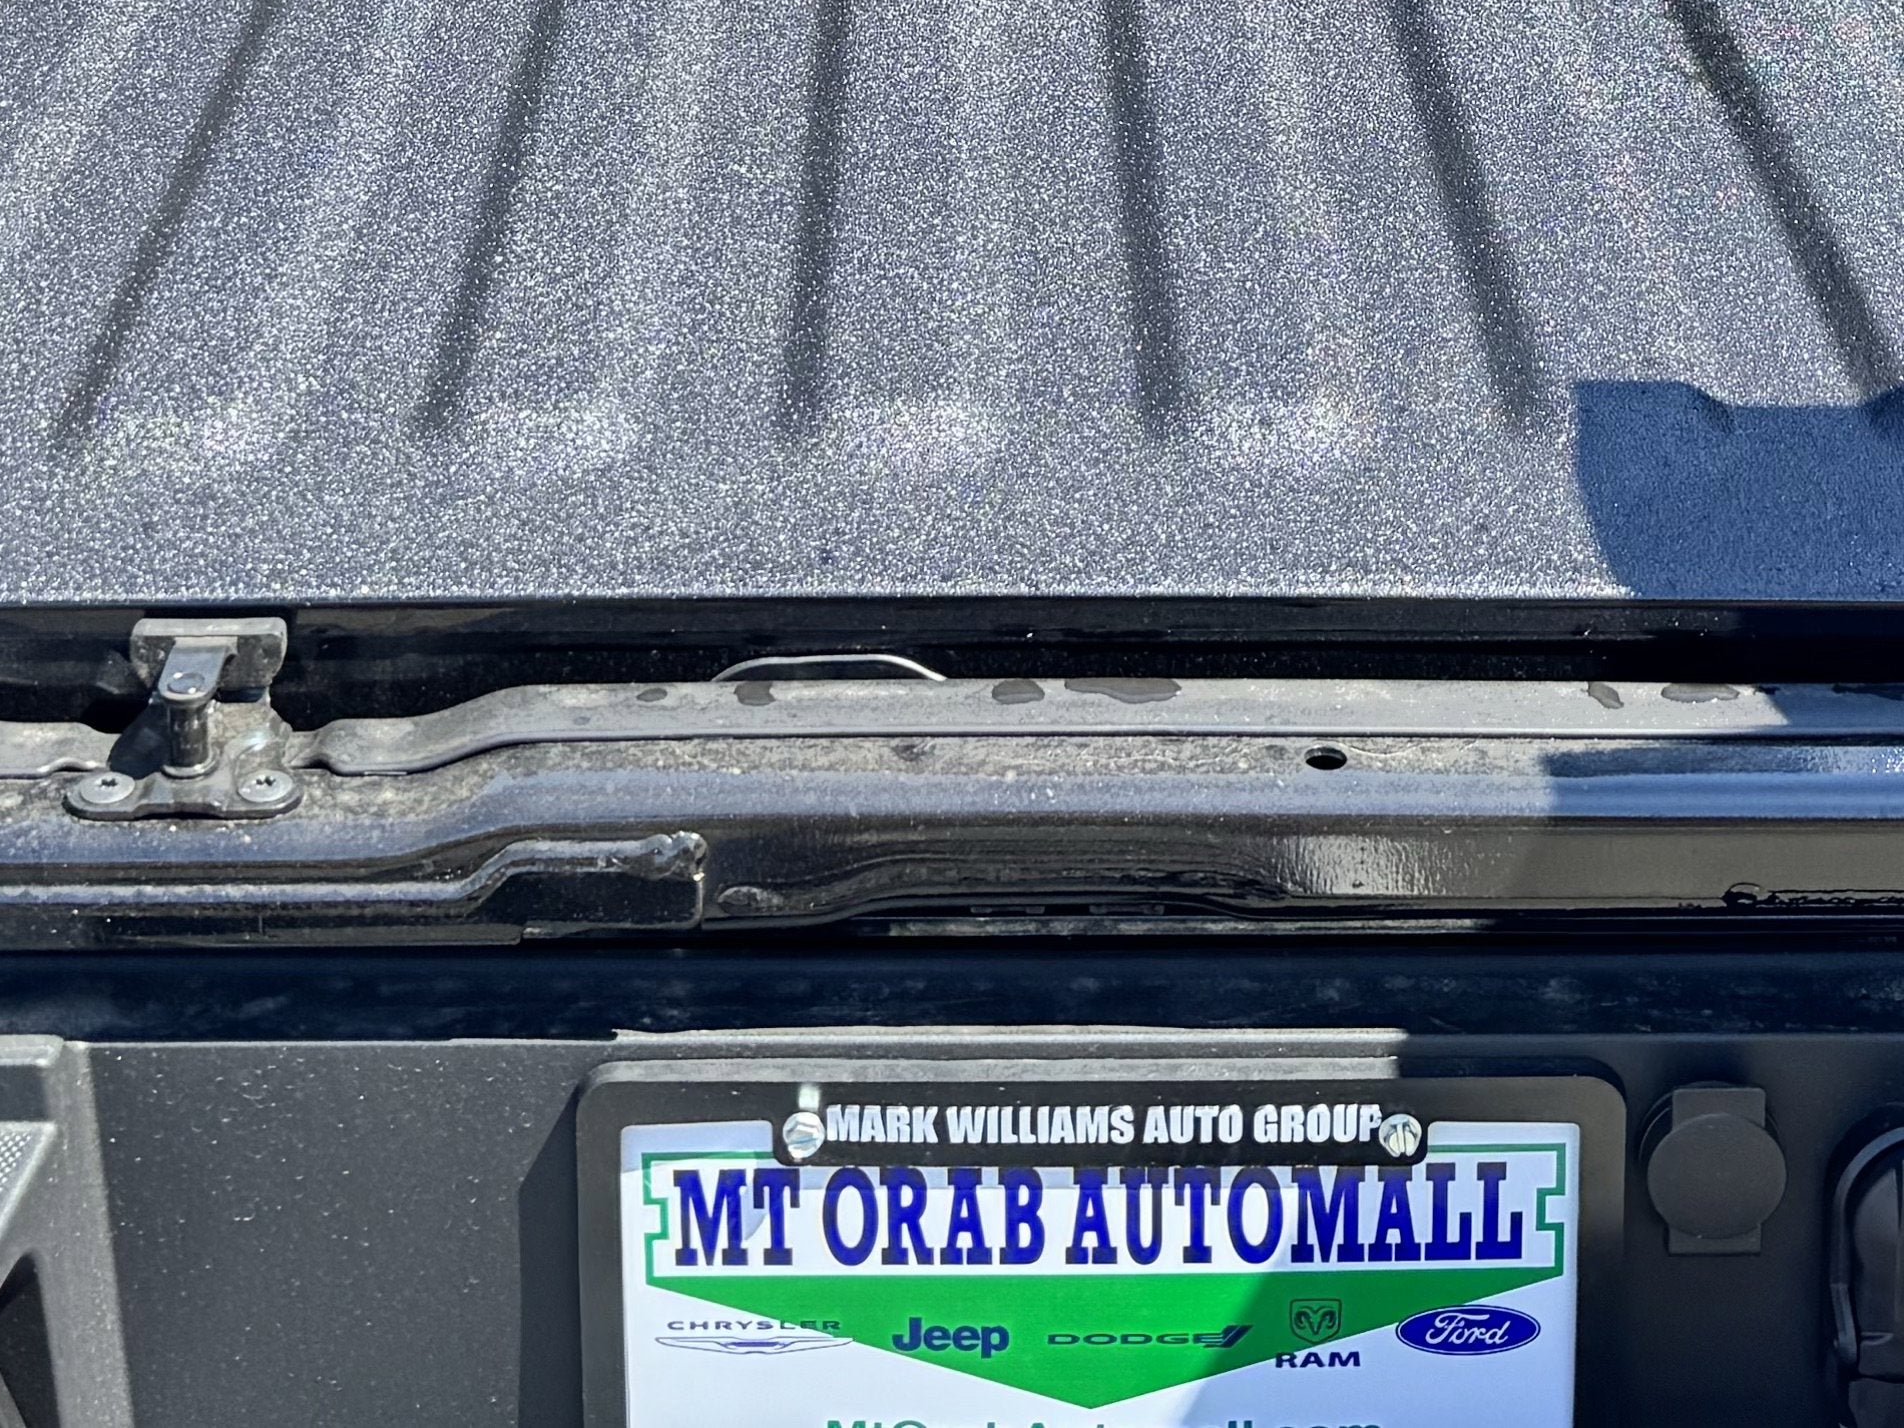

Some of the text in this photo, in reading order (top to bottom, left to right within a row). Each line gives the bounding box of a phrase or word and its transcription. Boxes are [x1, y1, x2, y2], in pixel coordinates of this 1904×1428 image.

[826, 1103, 1382, 1144] MARK WILLIAMS AUTO GROUP
[672, 1161, 1523, 1266] MT ORAB AUTOMALL
[667, 1320, 841, 1331] CHRYSLER
[892, 1317, 1010, 1359] Jeep
[1047, 1333, 1226, 1346] DODGE
[1425, 1312, 1511, 1346] Ford
[1275, 1351, 1361, 1369] RAM
